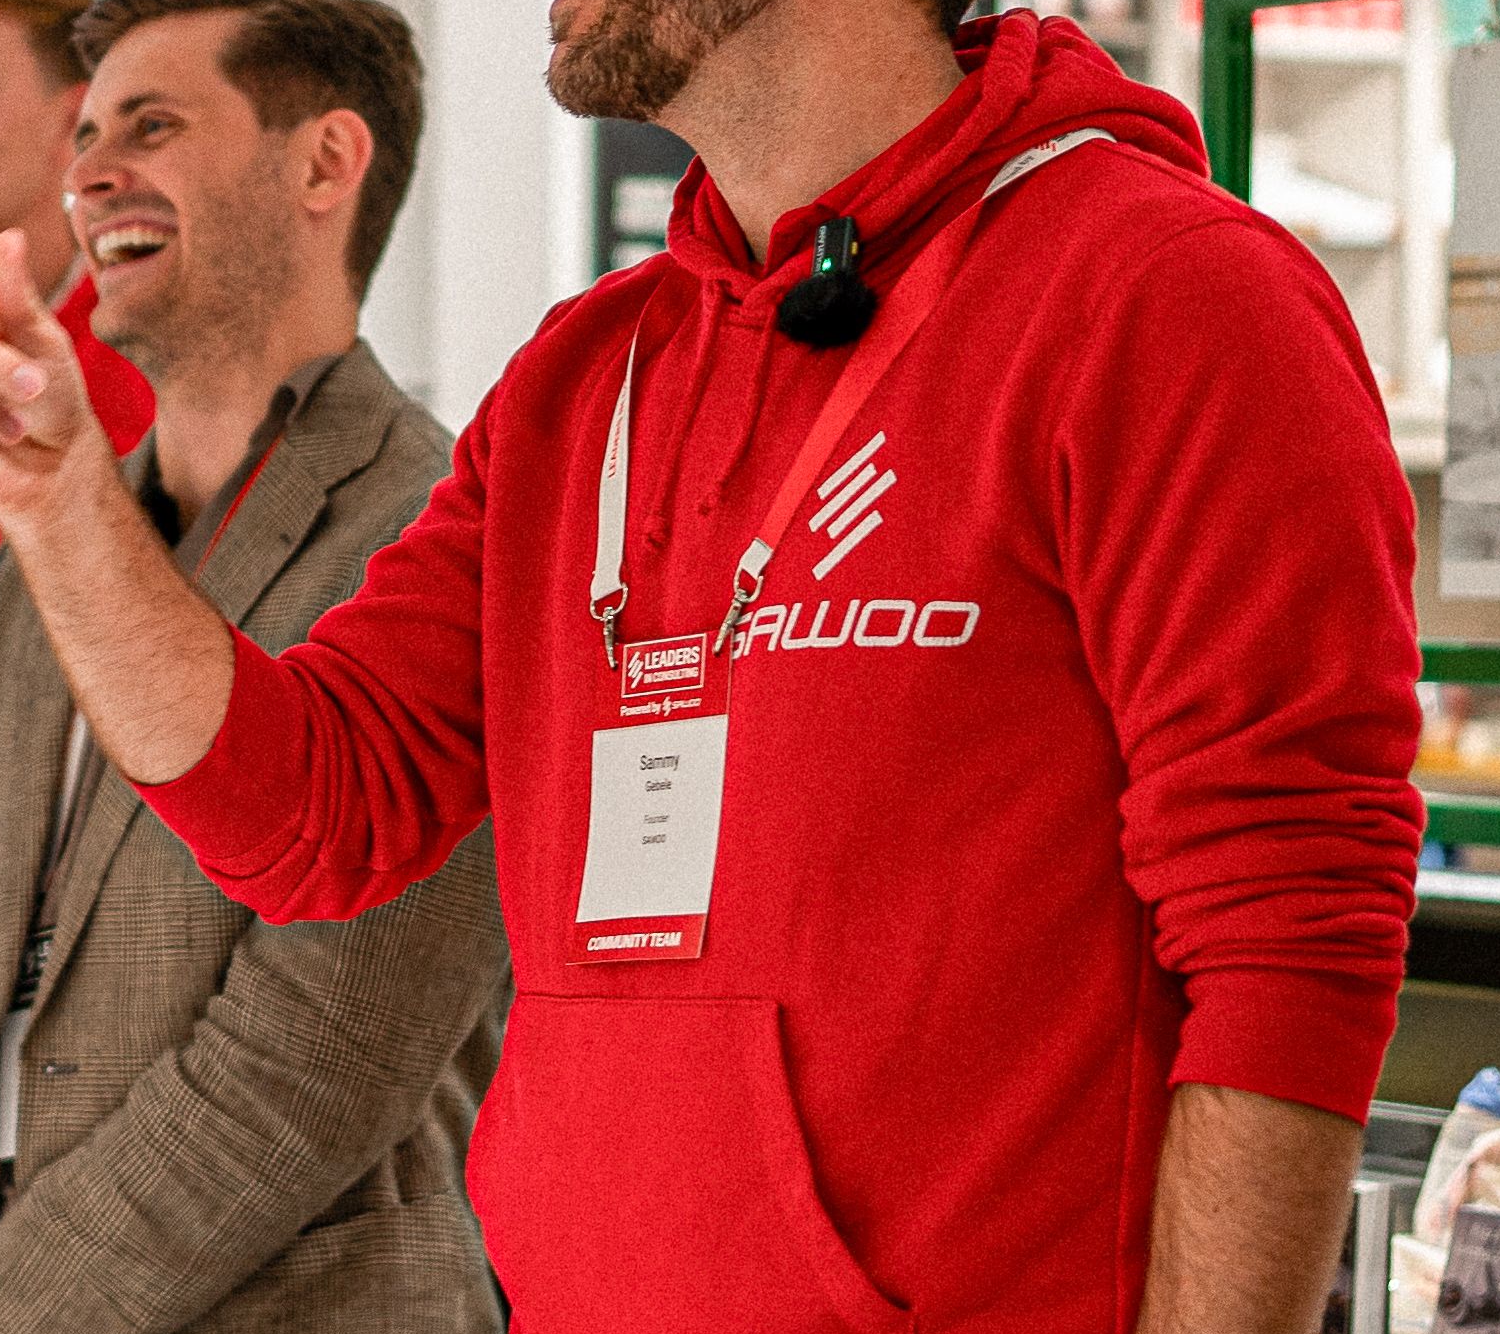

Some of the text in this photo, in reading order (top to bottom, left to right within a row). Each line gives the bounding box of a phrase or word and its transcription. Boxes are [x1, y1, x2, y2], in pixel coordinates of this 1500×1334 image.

[645, 646, 701, 670] LEADERS
[640, 754, 680, 771] Sammy
[586, 932, 682, 951] COMMUNITY TEAM
